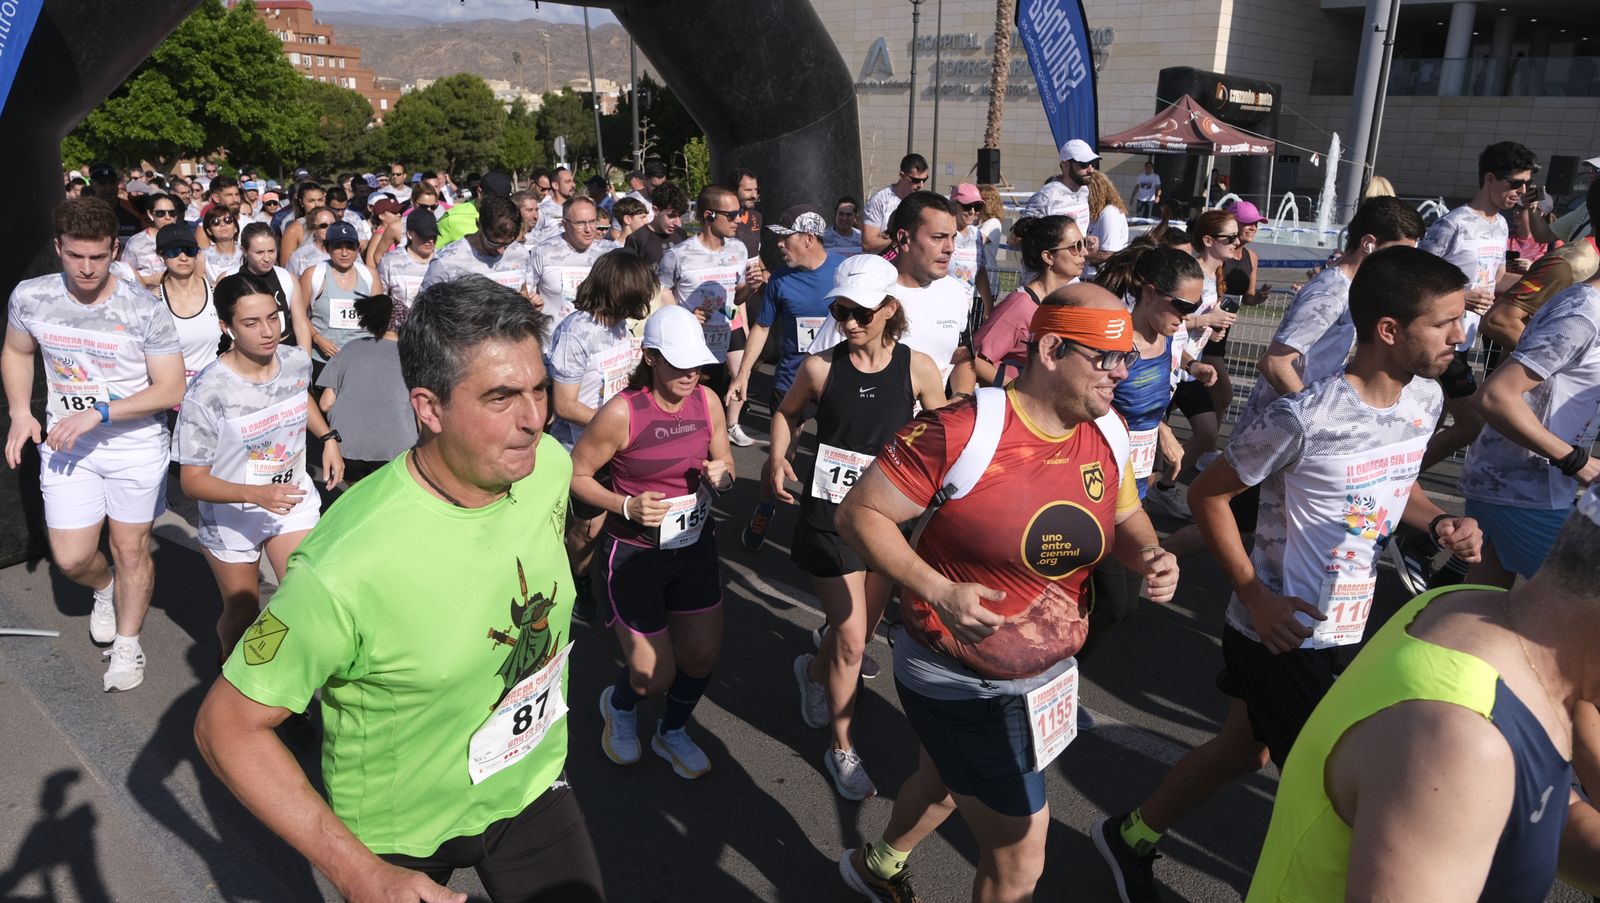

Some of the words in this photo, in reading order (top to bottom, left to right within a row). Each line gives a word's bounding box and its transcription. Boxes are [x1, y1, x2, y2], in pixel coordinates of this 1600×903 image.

[1356, 457, 1389, 476] CARRERA
[1390, 454, 1405, 466] SIN
[675, 503, 706, 531] 155
[1042, 534, 1063, 542] uno
[1040, 548, 1080, 558] cienmil
[1041, 542, 1072, 551] entre
[1036, 557, 1058, 566] .org
[512, 687, 551, 736] 87
[1038, 694, 1073, 738] 1155
